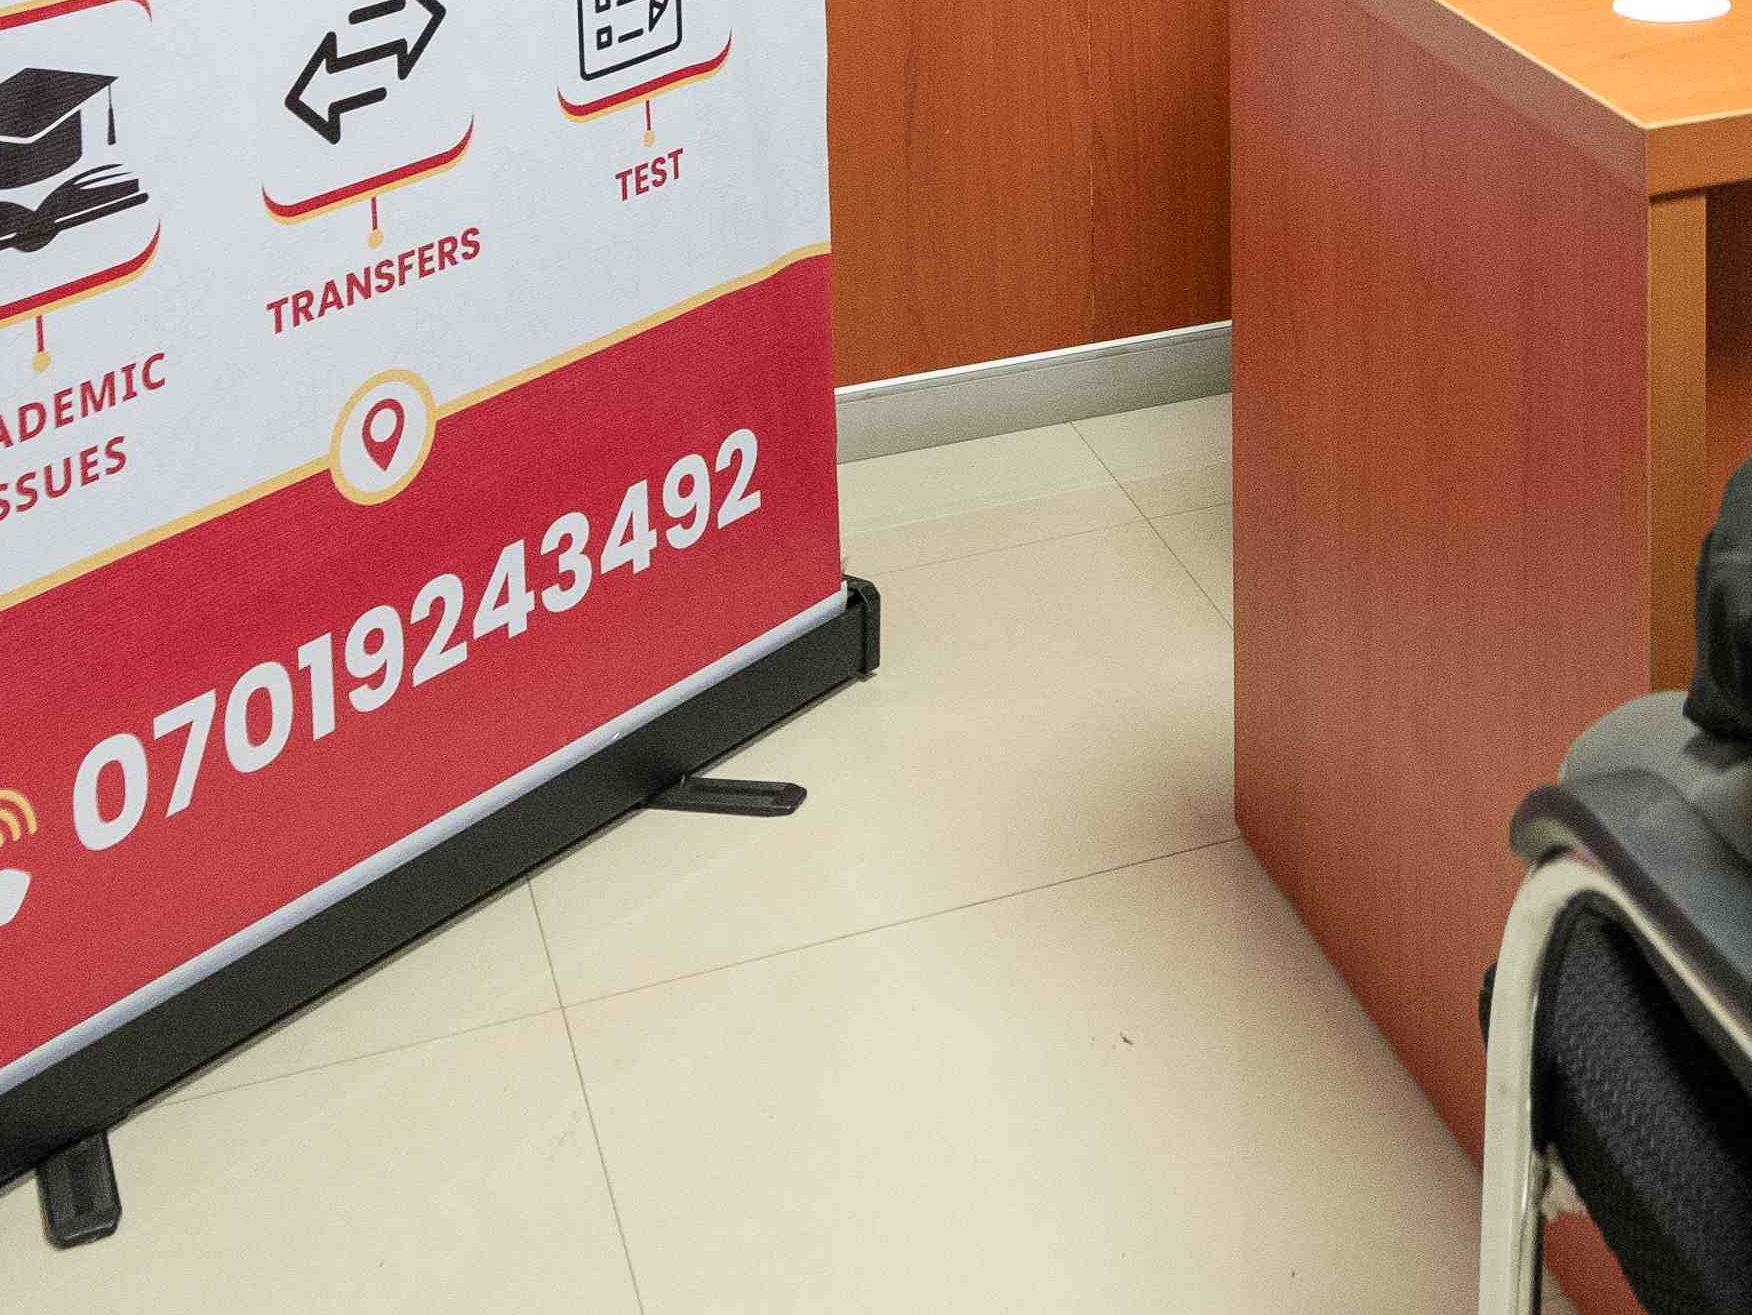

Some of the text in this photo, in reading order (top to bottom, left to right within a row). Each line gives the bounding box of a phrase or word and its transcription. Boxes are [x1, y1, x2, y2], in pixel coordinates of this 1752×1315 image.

[613, 149, 686, 205] TEST
[265, 228, 483, 336] TRANSFERS
[70, 426, 764, 854] 07019243492
